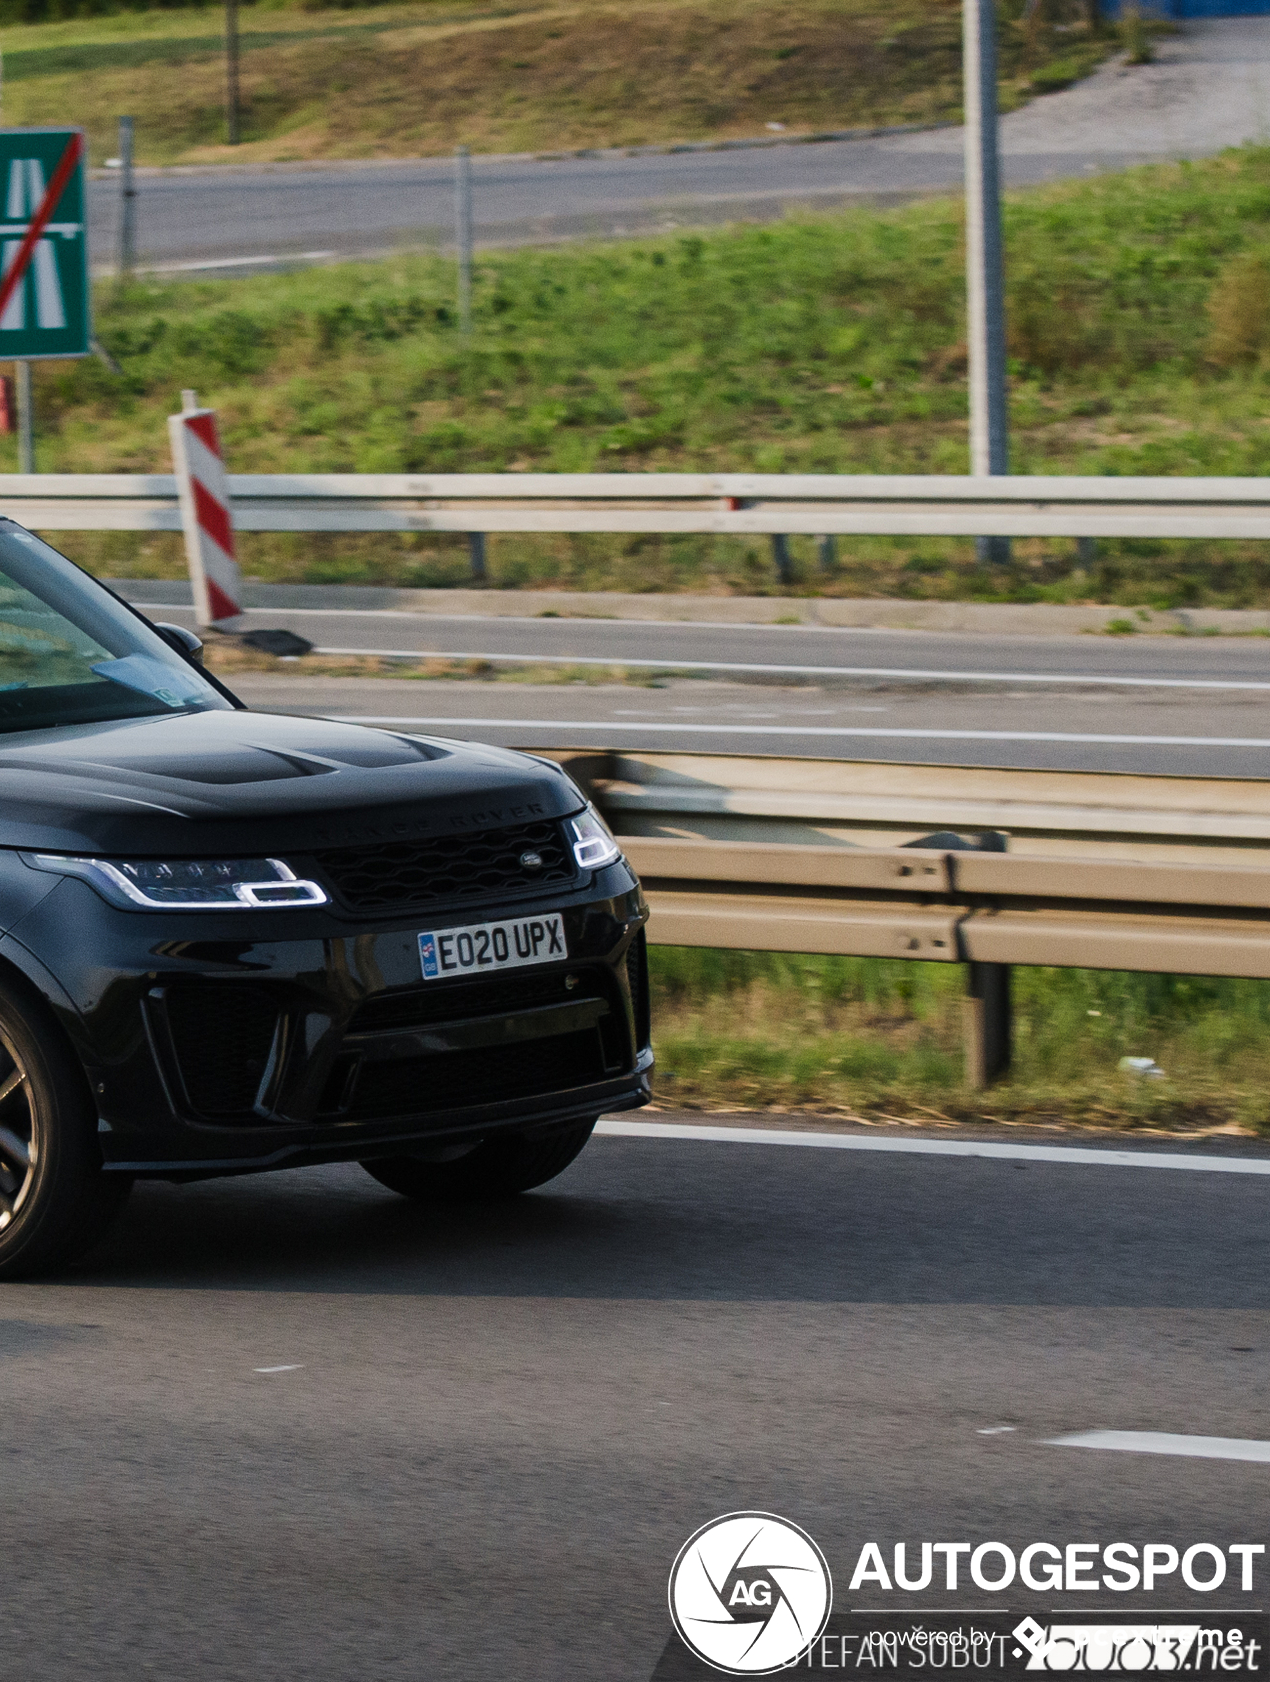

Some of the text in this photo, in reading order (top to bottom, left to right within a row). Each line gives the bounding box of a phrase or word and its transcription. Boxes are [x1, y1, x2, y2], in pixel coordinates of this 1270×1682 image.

[449, 803, 545, 828] ROVER
[437, 918, 563, 971] EO20 UPX
